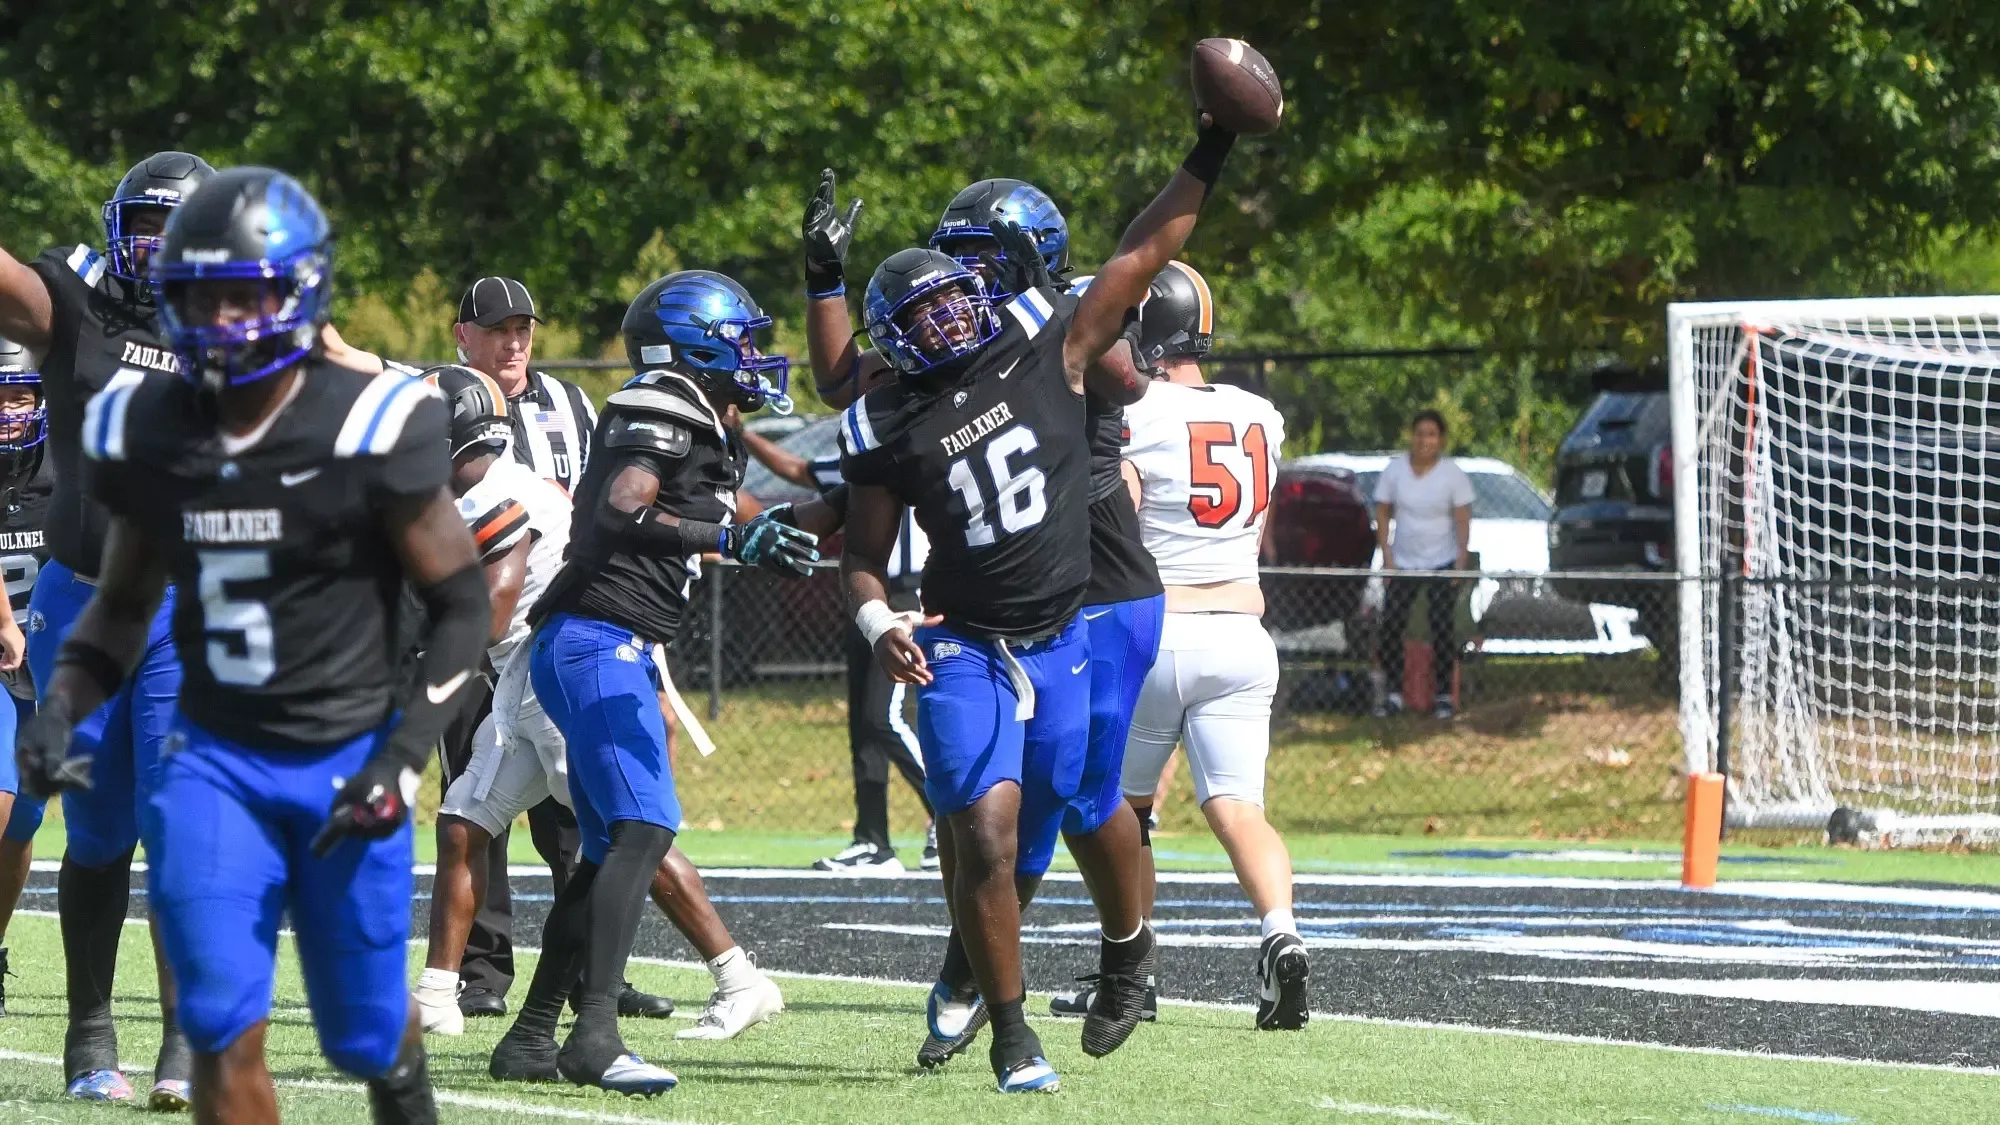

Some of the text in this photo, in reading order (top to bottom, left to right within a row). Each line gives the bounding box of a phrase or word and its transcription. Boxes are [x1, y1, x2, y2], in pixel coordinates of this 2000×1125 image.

[121, 341, 184, 374] FAULKN
[940, 401, 1014, 457] FAULKNER
[553, 453, 570, 479] U
[946, 423, 1048, 548] 16
[1186, 421, 1269, 529] 51
[0, 530, 46, 550] ULKNE
[181, 508, 283, 543] FAULKNER
[197, 549, 277, 687] 5
